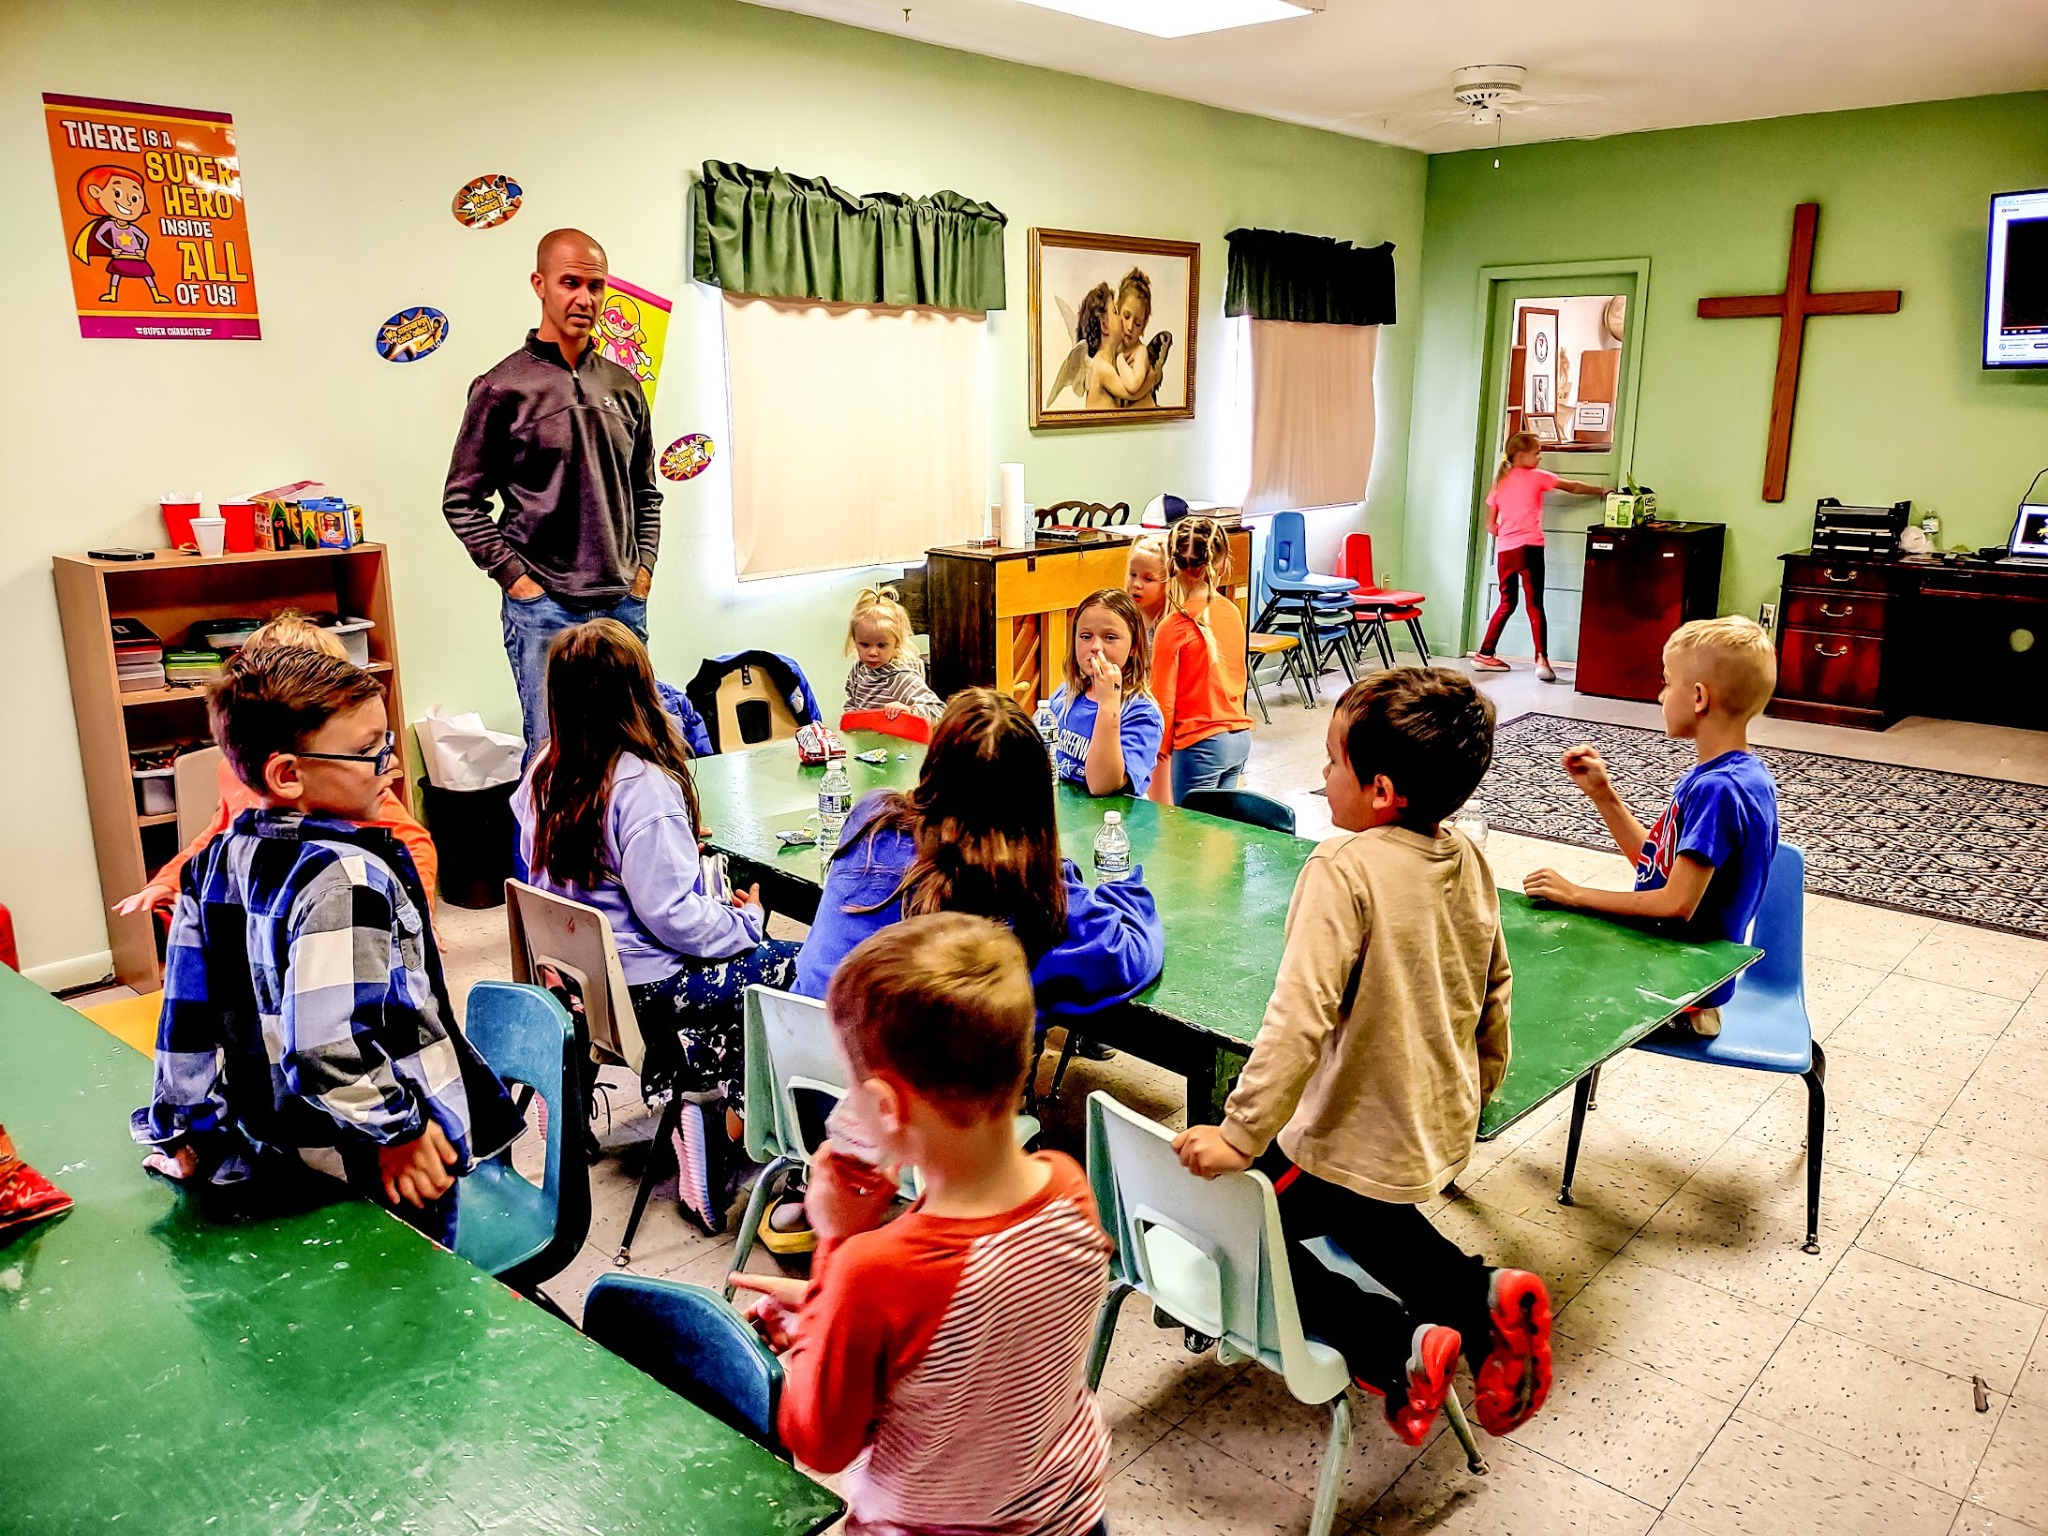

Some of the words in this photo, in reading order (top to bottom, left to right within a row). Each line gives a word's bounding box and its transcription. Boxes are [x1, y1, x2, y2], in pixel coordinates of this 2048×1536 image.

[61, 120, 141, 153] THERE
[142, 128, 159, 146] IS
[160, 130, 172, 148] A
[145, 151, 234, 188] SUPER
[163, 184, 233, 219] HERO
[470, 193, 485, 205] We
[484, 189, 498, 200] are
[160, 217, 213, 238] INSIDE
[178, 240, 248, 283] ALL
[176, 283, 200, 305] OF
[204, 284, 237, 306] US!
[142, 327, 166, 336] SUPER
[167, 327, 207, 336] CHARACTER
[1058, 728, 1091, 762] GREENW
